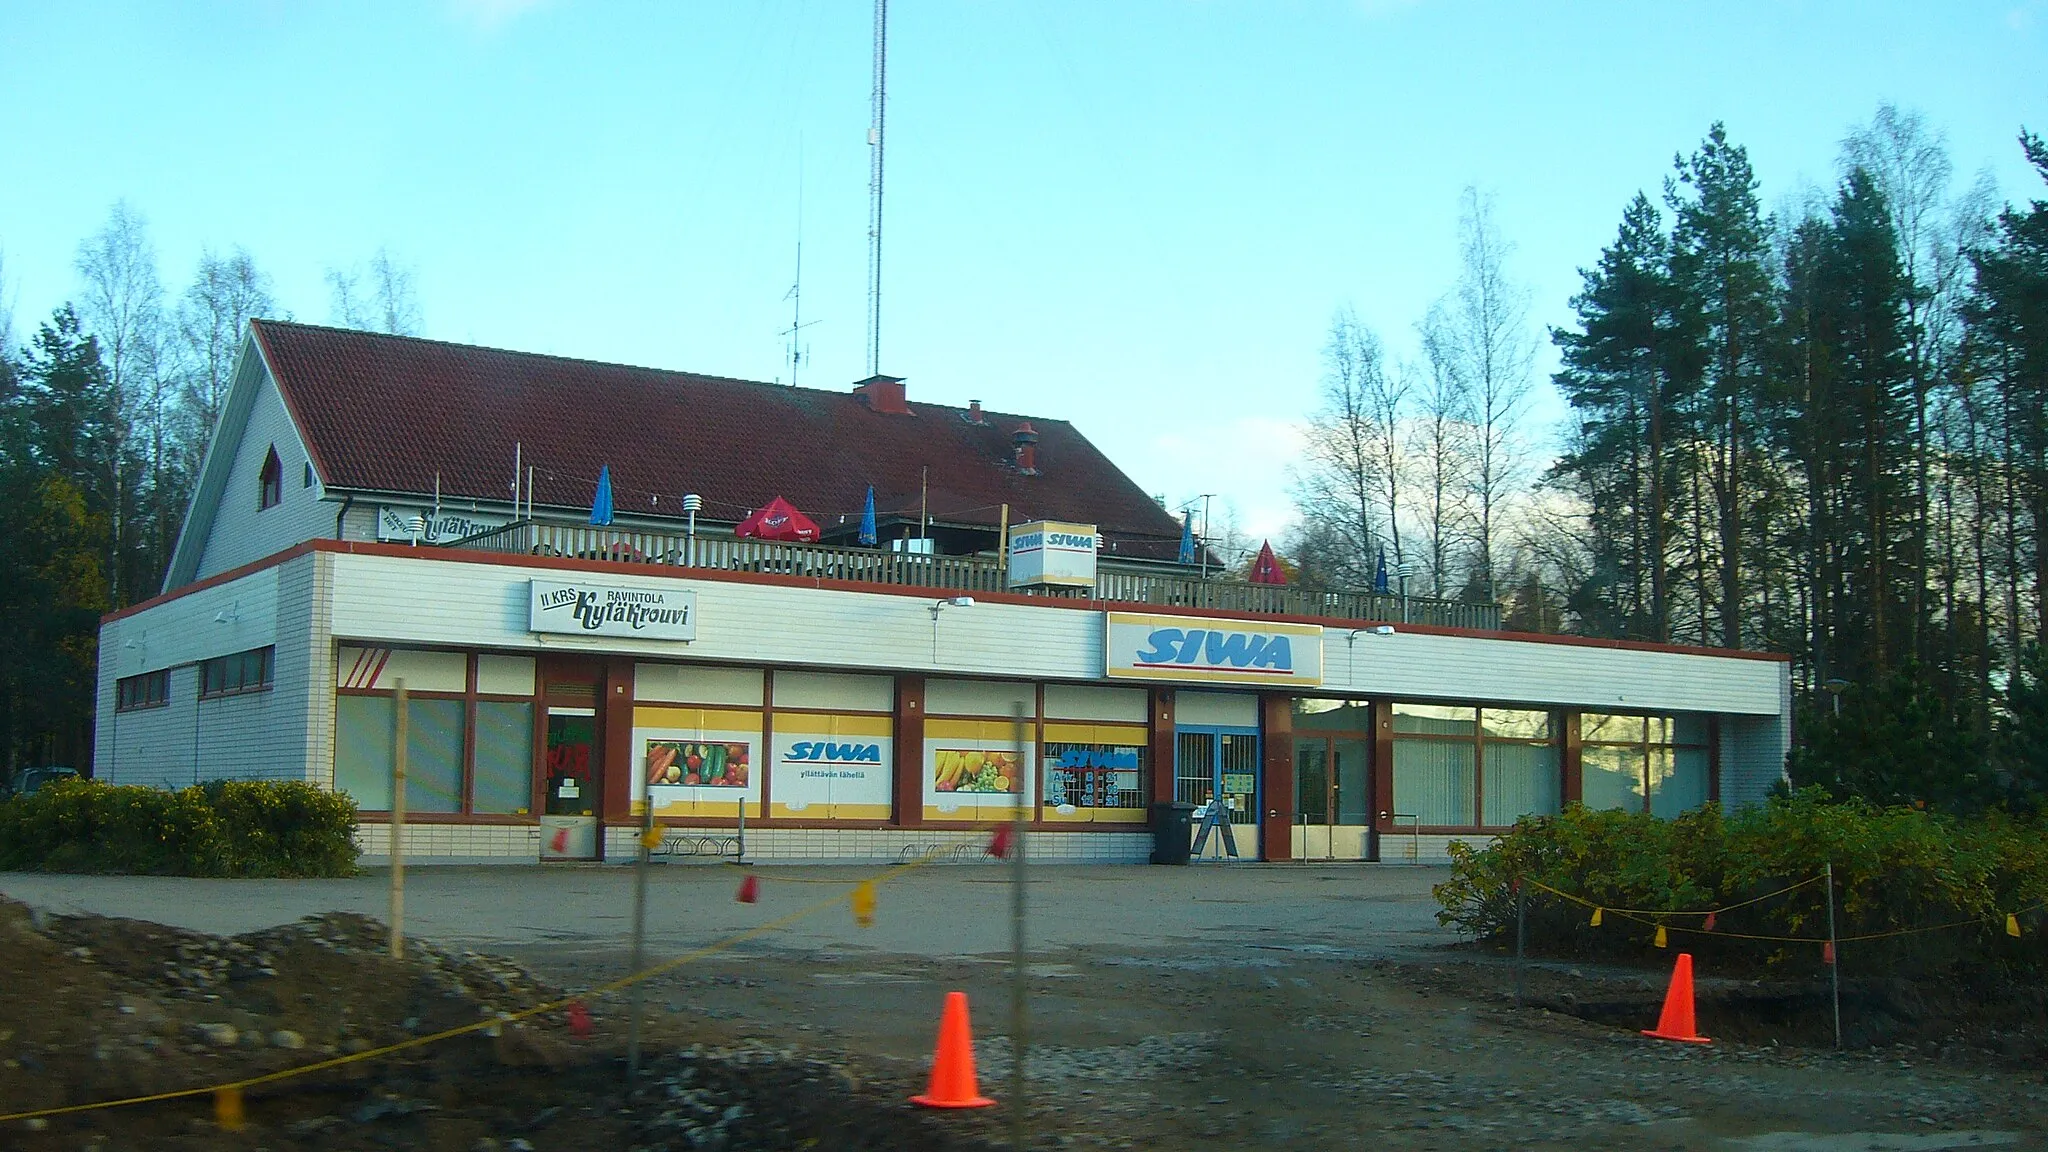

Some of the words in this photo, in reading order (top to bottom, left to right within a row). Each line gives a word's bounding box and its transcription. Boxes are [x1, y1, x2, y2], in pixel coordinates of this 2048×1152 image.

[1013, 533, 1042, 549] SIWA
[1047, 533, 1092, 549] SIWA
[551, 588, 577, 604] KRS
[607, 590, 664, 604] RAVINTOLA
[1136, 628, 1292, 670] SIWA
[784, 741, 881, 762] SIWA
[800, 770, 838, 778] yllättävän
[1053, 784, 1066, 794] La
[1052, 795, 1067, 805] Su
